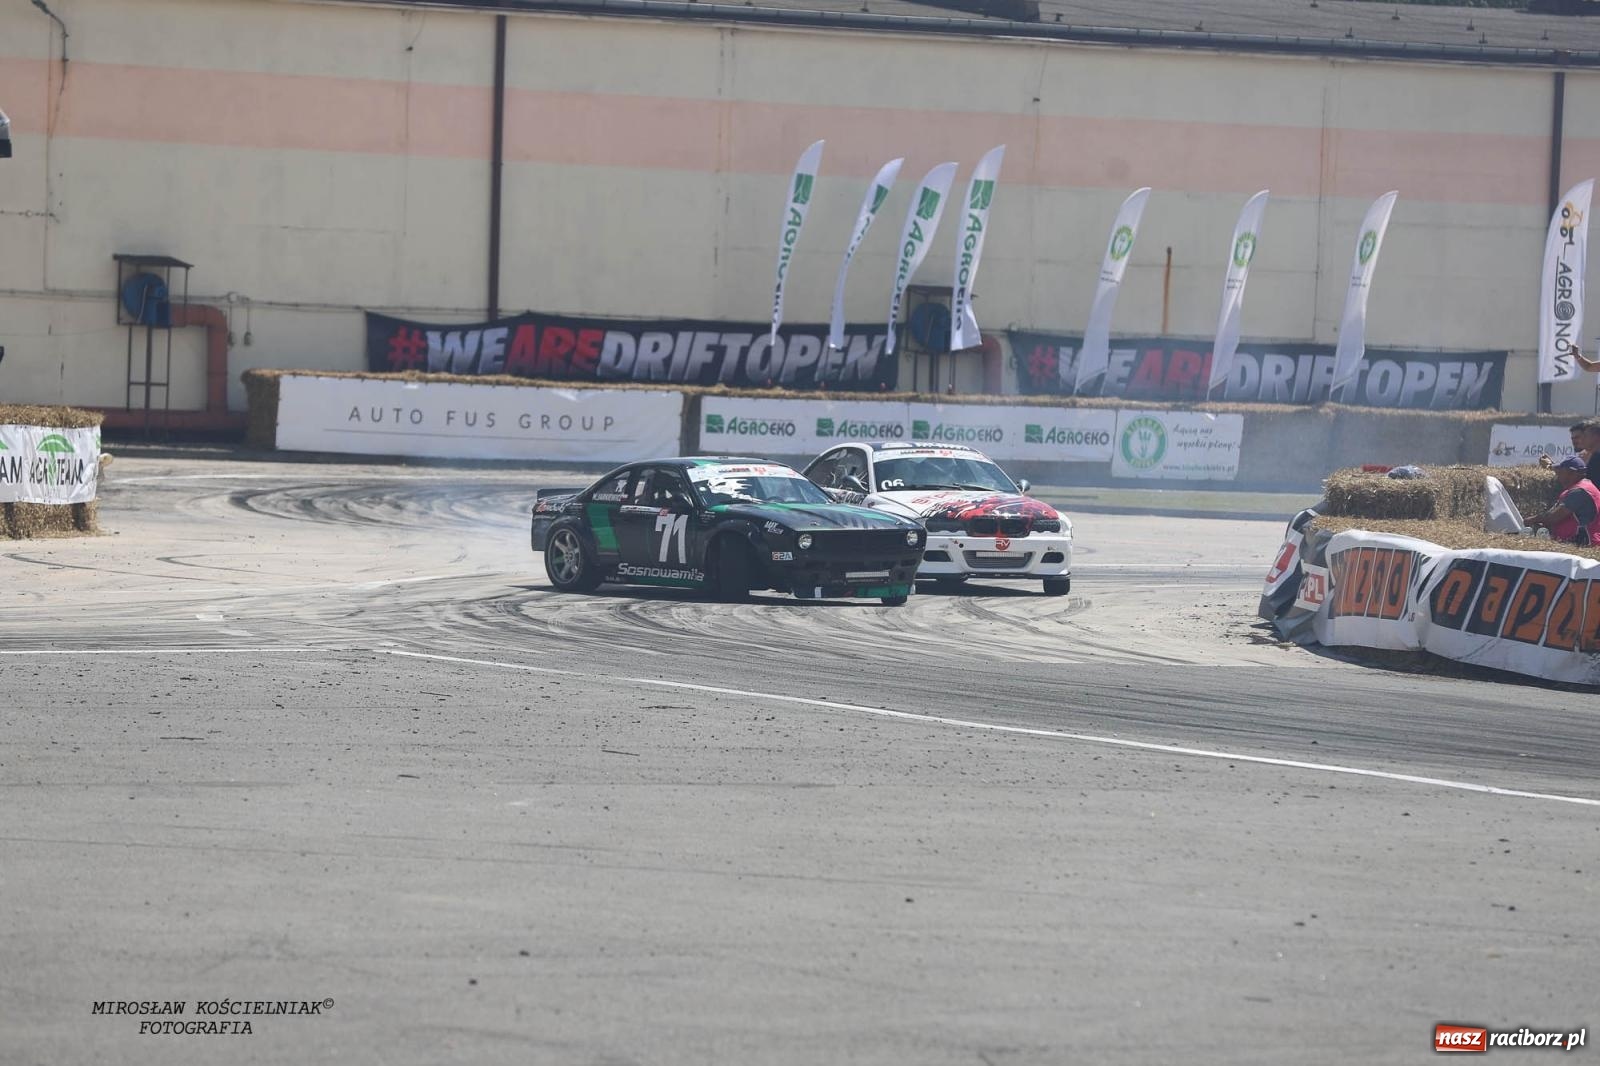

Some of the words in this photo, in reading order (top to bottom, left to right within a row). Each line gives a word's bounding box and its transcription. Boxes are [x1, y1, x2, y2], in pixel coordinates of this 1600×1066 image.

[348, 406, 424, 426] AUTO
[446, 410, 497, 429] FUS
[518, 413, 616, 432] GROUP
[726, 416, 796, 437] AGROEKO
[836, 419, 904, 439] AGROEKO
[931, 423, 1004, 443] AGROEKO
[1044, 425, 1110, 446] AGROEKO
[655, 513, 689, 564] 71
